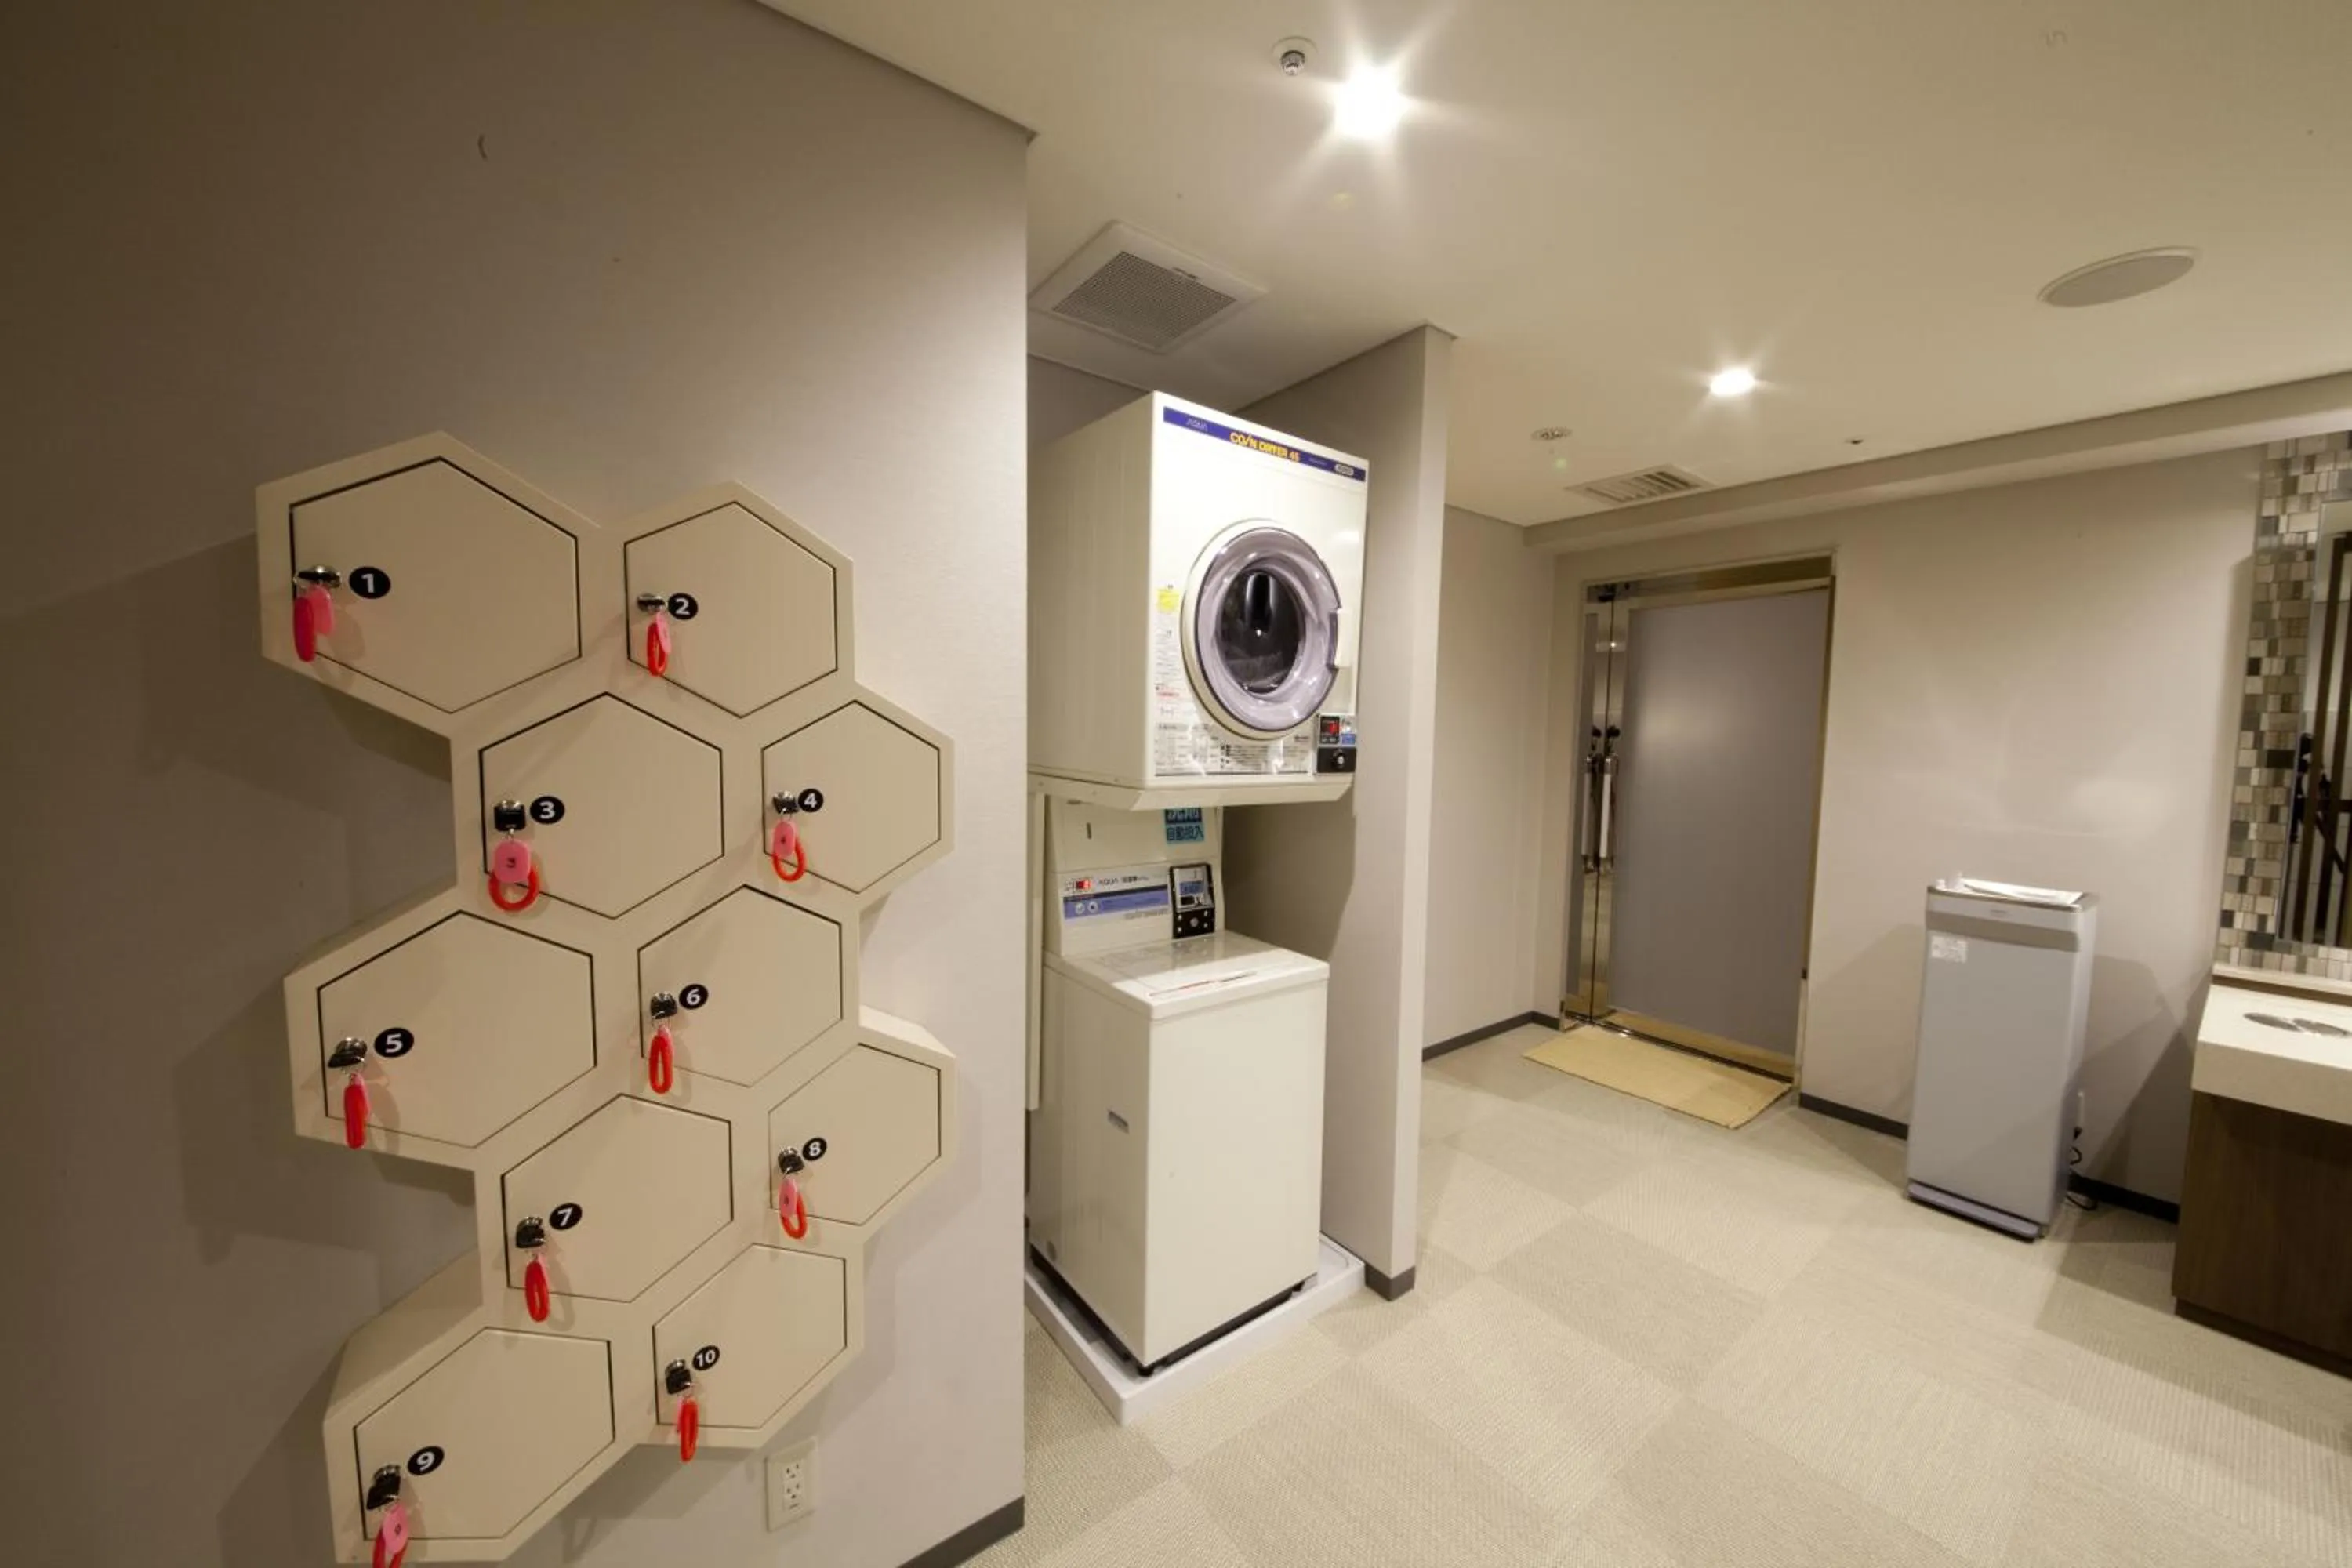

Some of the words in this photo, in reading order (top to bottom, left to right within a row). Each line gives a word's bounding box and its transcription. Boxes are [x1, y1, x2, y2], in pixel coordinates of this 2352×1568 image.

[361, 573, 374, 593] 1
[676, 597, 690, 615] 2
[804, 793, 817, 808] 4
[540, 801, 555, 819] 3
[686, 988, 701, 1005] 6
[386, 1033, 402, 1053] 5
[808, 1141, 822, 1157] 8
[557, 1207, 573, 1226] 7
[696, 1349, 716, 1367] 10
[417, 1451, 434, 1471] 9
